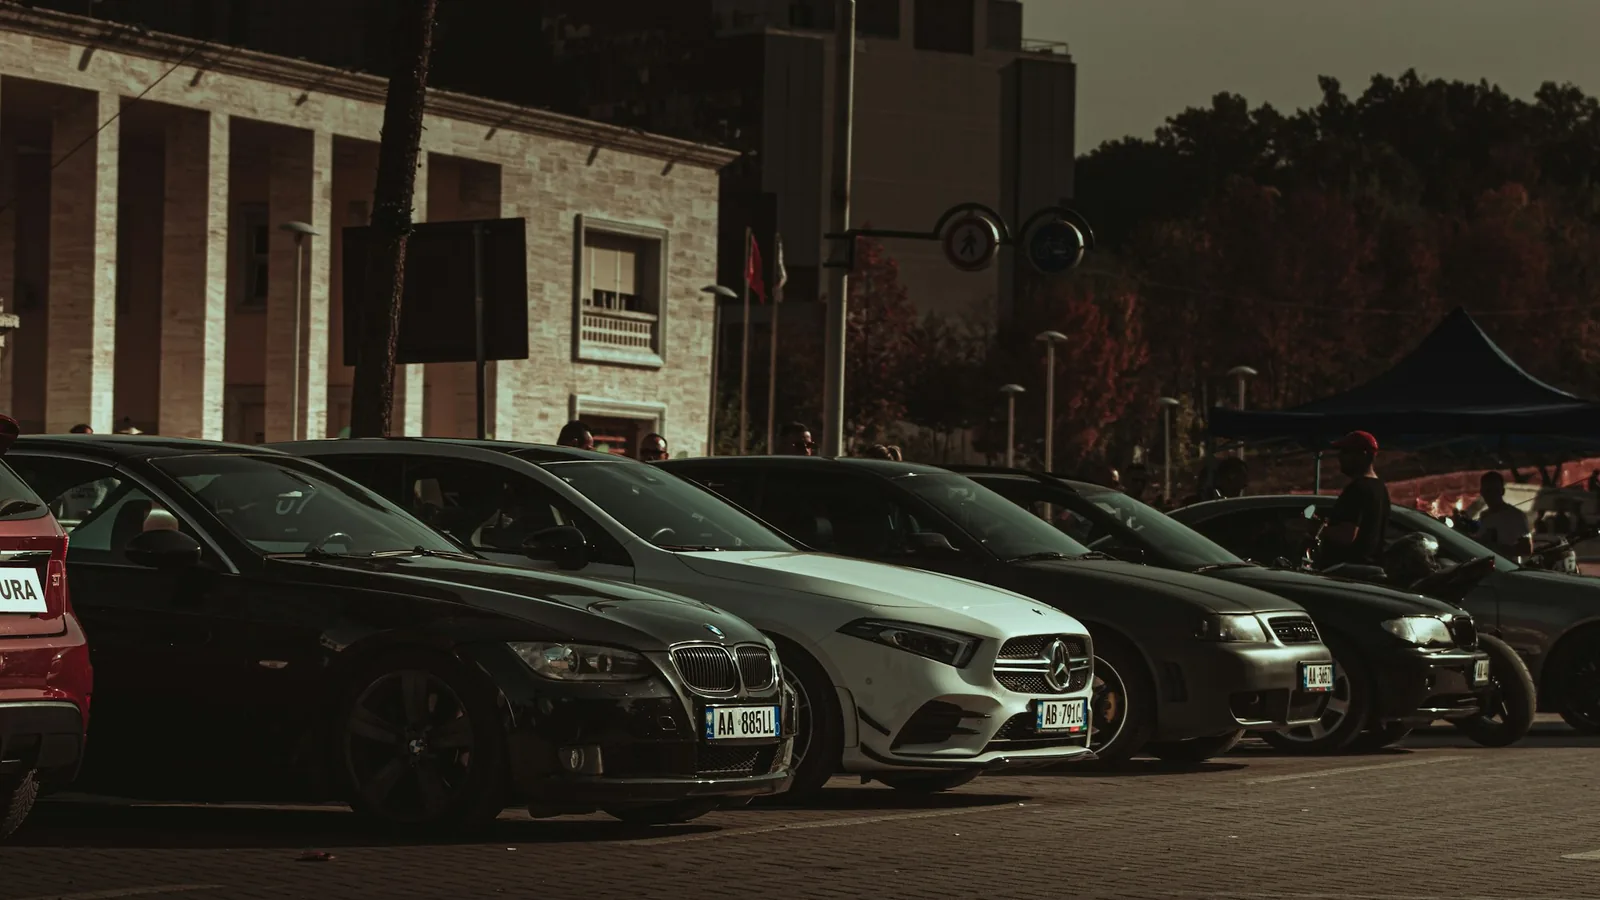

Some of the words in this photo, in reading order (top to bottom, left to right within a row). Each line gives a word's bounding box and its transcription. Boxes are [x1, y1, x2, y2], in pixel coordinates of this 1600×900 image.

[0, 579, 38, 600] URA
[1308, 667, 1316, 684] AA
[718, 711, 734, 735] AA
[741, 710, 774, 734] 885LL
[1045, 704, 1057, 725] AB
